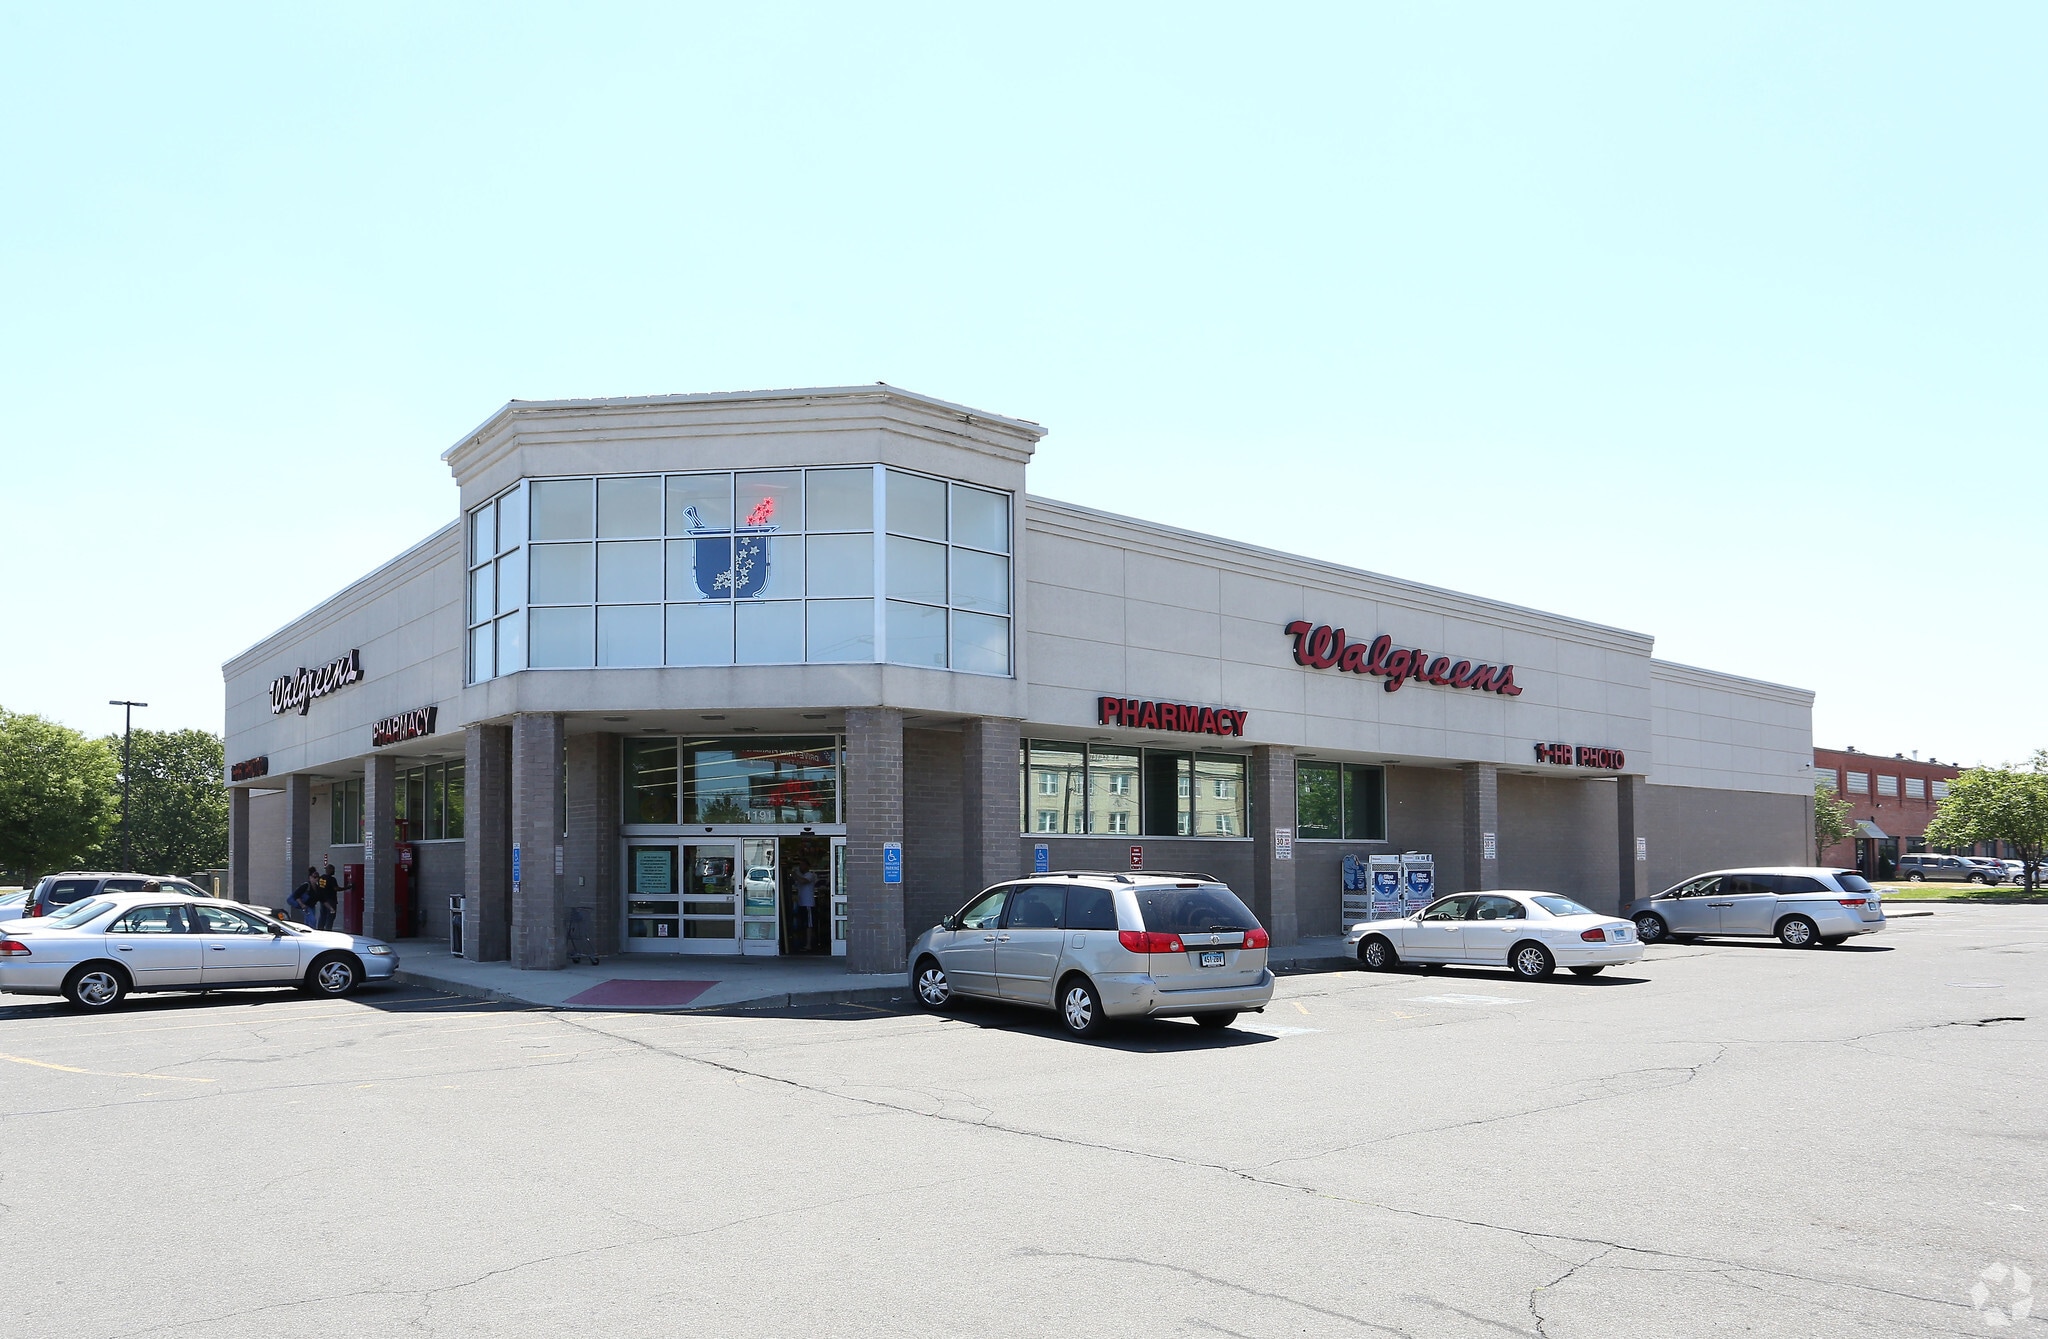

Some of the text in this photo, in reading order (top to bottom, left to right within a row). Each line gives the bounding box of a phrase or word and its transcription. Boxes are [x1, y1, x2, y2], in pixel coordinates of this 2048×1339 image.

[1284, 620, 1523, 697] Walgreens
[269, 648, 364, 716] Walgreens
[372, 706, 437, 746] PHARMACY
[1098, 697, 1248, 736] PHARMACY
[1533, 743, 1625, 769] 1-HR PHOTO
[746, 810, 773, 821] 1191
